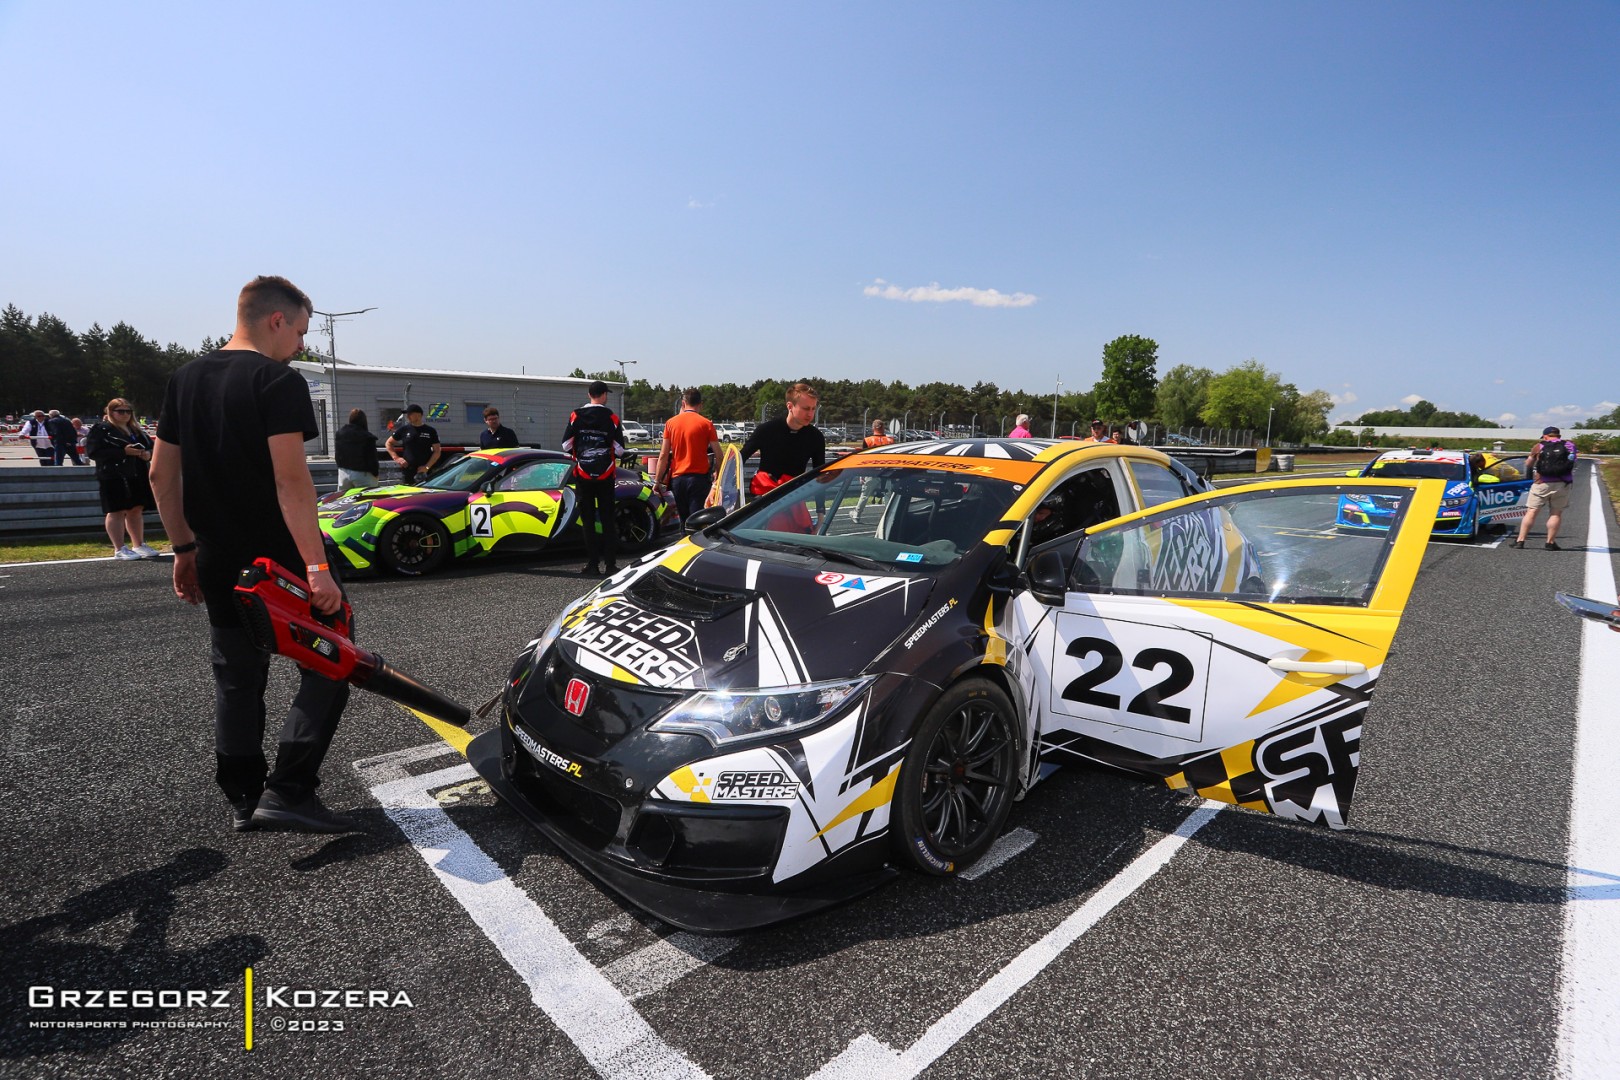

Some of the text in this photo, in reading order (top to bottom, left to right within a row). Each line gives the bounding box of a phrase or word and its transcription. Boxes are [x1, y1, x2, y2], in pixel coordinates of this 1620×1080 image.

[1478, 489, 1515, 506] Nice
[473, 506, 490, 535] 2
[596, 602, 691, 651] SPEED
[904, 597, 959, 650] SPEEDMASTERS.PL
[564, 618, 692, 688] MASTERS
[1061, 636, 1195, 724] 22
[513, 724, 583, 778] SPEEDMASTERS.PL
[715, 785, 798, 799] MASTERS
[719, 772, 785, 786] SPEED
[917, 839, 944, 871] MICHELIN
